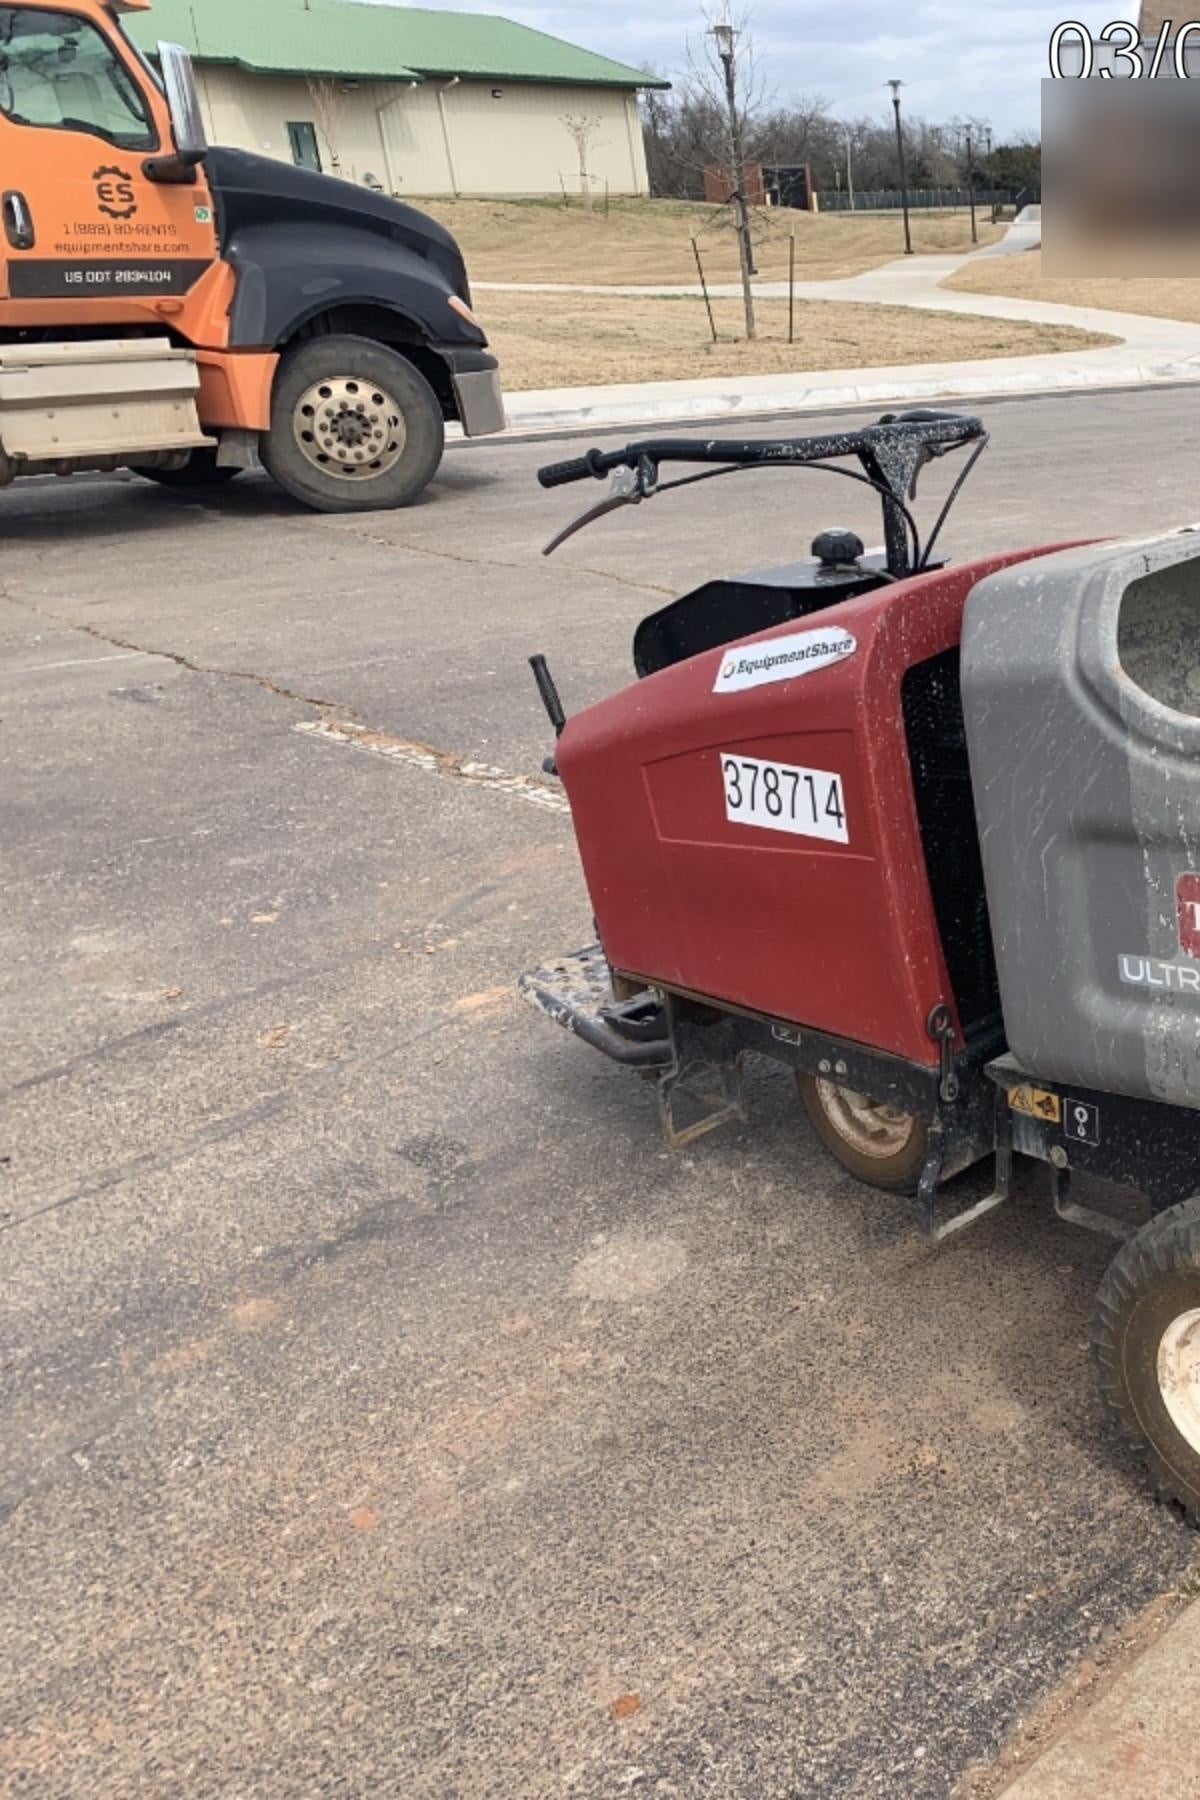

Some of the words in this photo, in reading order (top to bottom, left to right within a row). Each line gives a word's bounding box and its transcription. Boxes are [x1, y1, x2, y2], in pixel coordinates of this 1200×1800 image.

[97, 183, 135, 202] ES
[54, 241, 190, 254] equipmentshare.com
[64, 270, 83, 283] US
[86, 270, 111, 283] DOT
[736, 639, 853, 674] EquipmentShare
[724, 759, 844, 828] 378714
